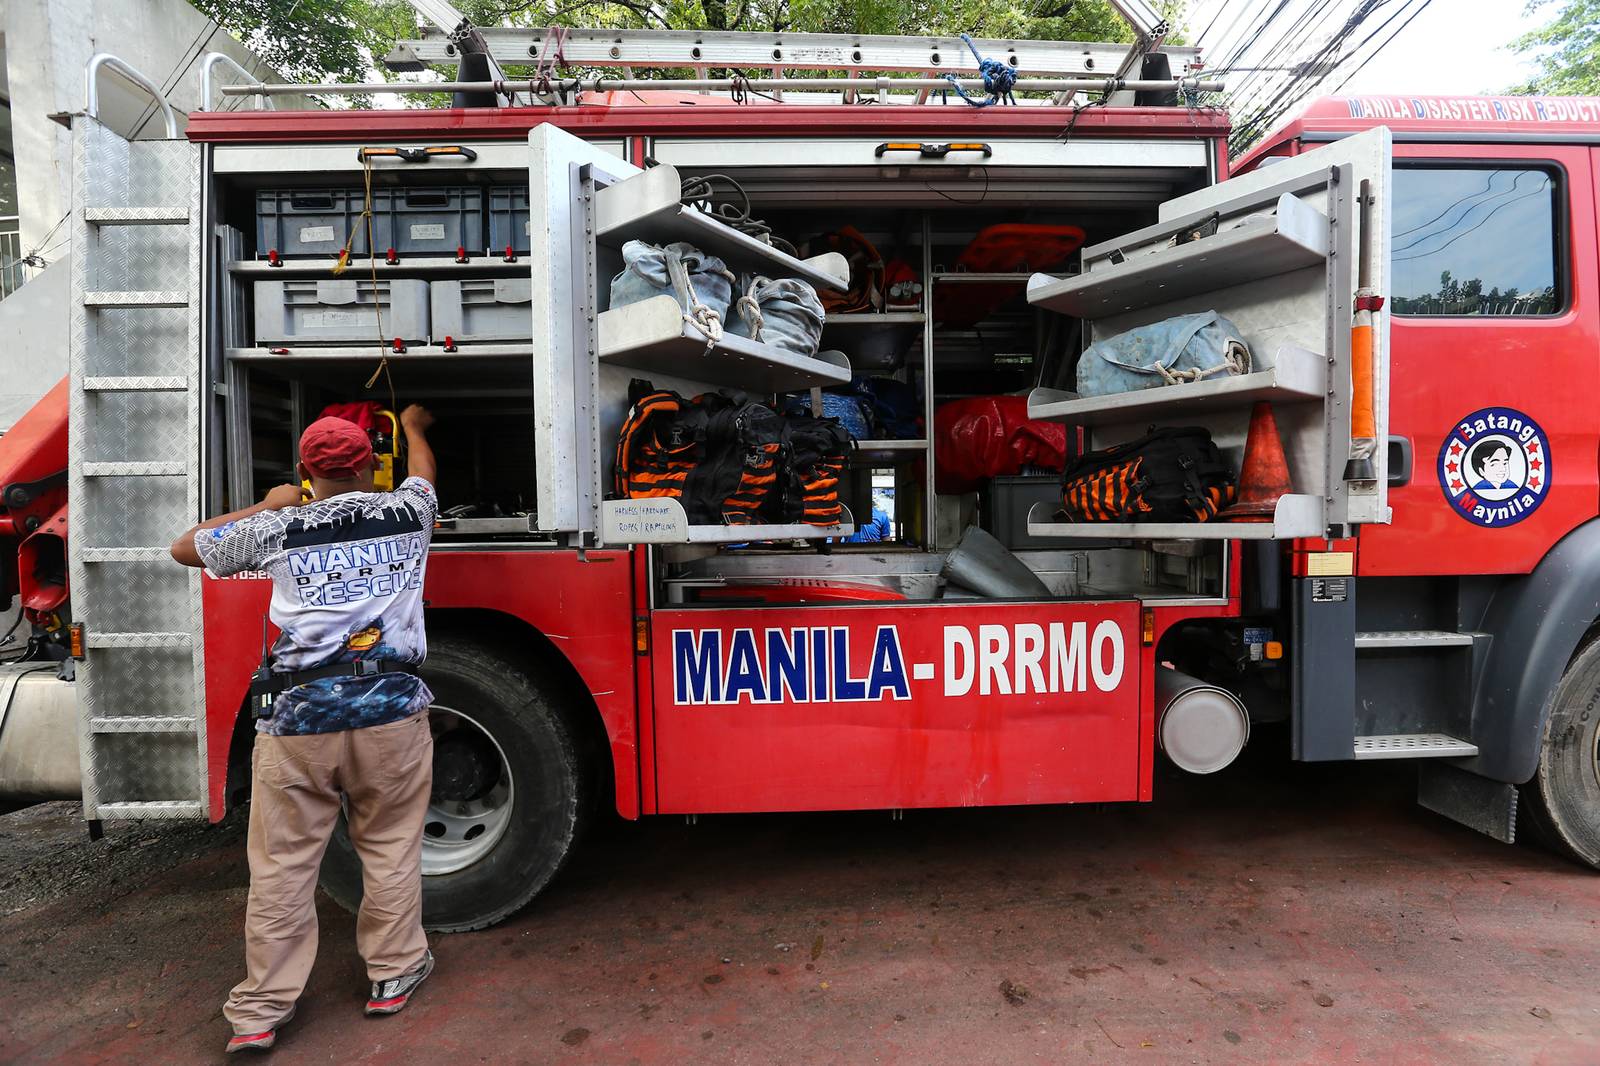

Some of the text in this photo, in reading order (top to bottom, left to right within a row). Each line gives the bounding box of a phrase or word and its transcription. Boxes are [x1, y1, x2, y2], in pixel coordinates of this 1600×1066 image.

[1347, 98, 1412, 119] MANILA
[1411, 98, 1492, 121] DISASTER
[1493, 99, 1534, 121] RISK
[1459, 412, 1536, 442] Batang
[1458, 492, 1535, 524] Maynila
[287, 536, 423, 577] MANILA
[298, 567, 422, 609] RESCUE
